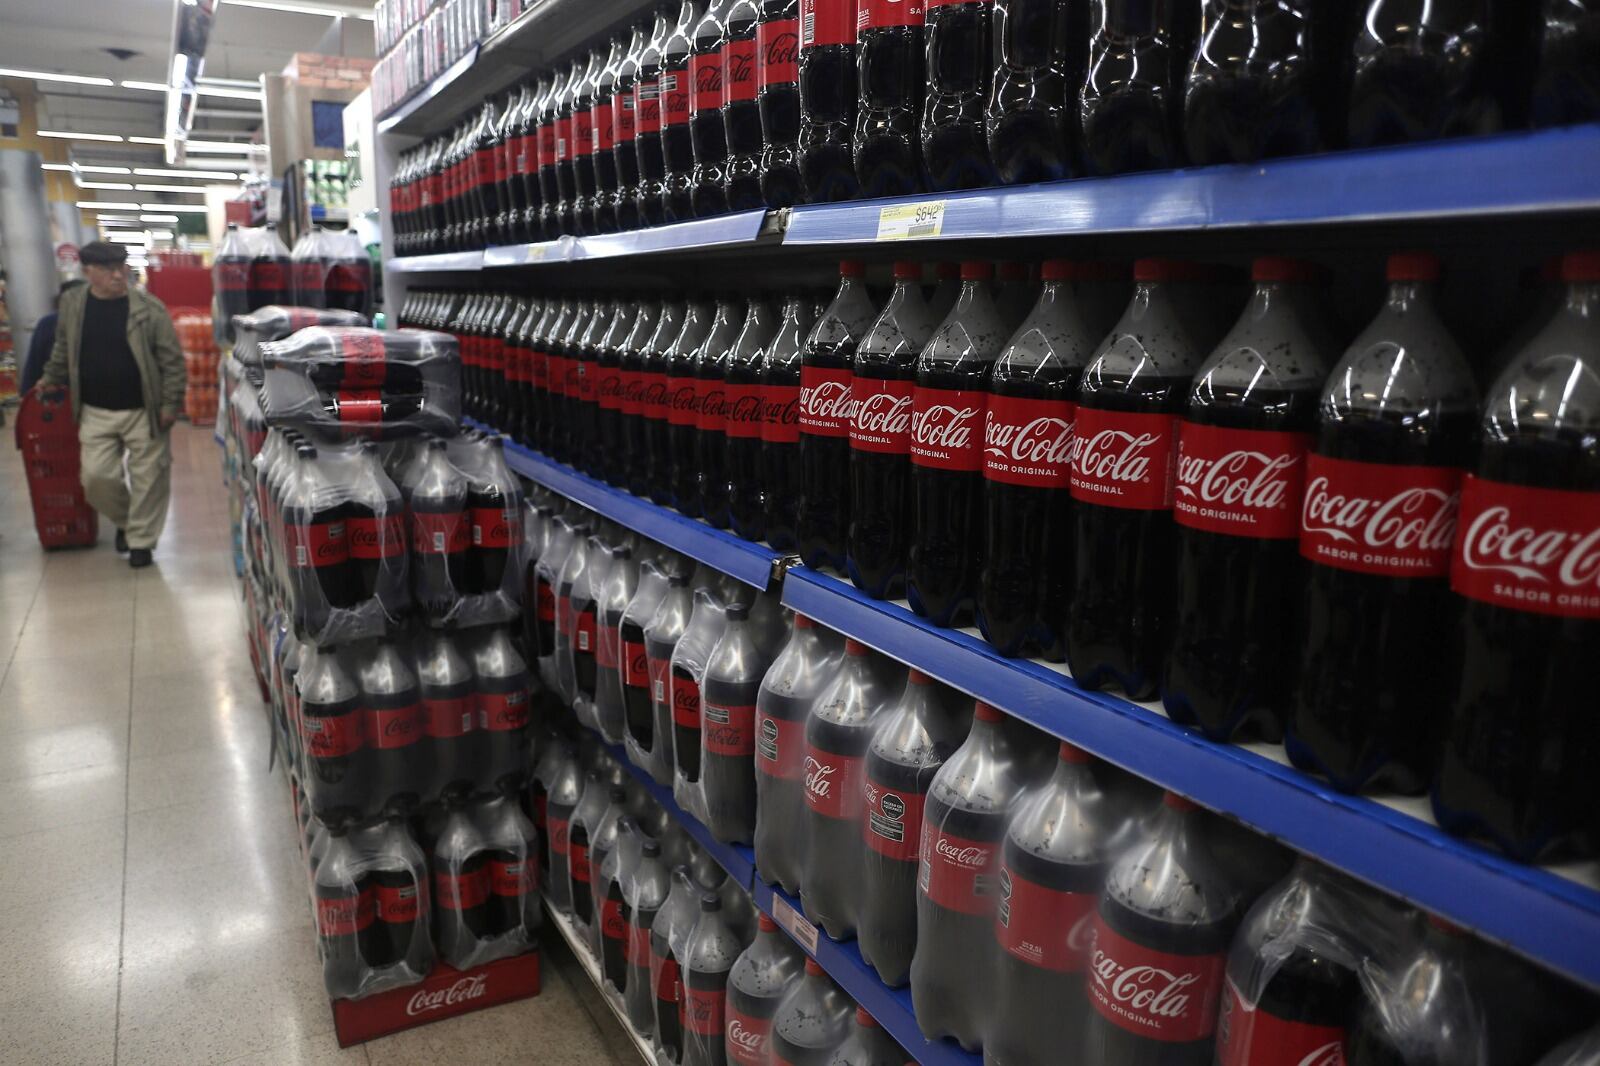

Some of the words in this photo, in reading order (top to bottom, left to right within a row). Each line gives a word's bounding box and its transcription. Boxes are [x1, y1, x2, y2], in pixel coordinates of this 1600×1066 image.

[808, 418, 840, 428] ORIGINAL
[850, 393, 913, 433] a-Cola
[911, 405, 981, 449] a-Cola
[857, 434, 892, 444] ORIGINAL
[917, 447, 950, 459] ORIGINAL
[987, 460, 1009, 471] SABOR
[1011, 465, 1059, 477] ORIGINAL
[1080, 481, 1124, 496] ORIGINAL
[1199, 507, 1257, 524] ORIGINAL
[1302, 476, 1458, 550] Coca-Cola
[1317, 544, 1358, 562] SABOR
[1362, 553, 1432, 568] ORIGINAL
[1493, 583, 1551, 603] SABOR
[1556, 594, 1600, 608] ORIG
[1110, 1002, 1161, 1029] ORIGINAL
